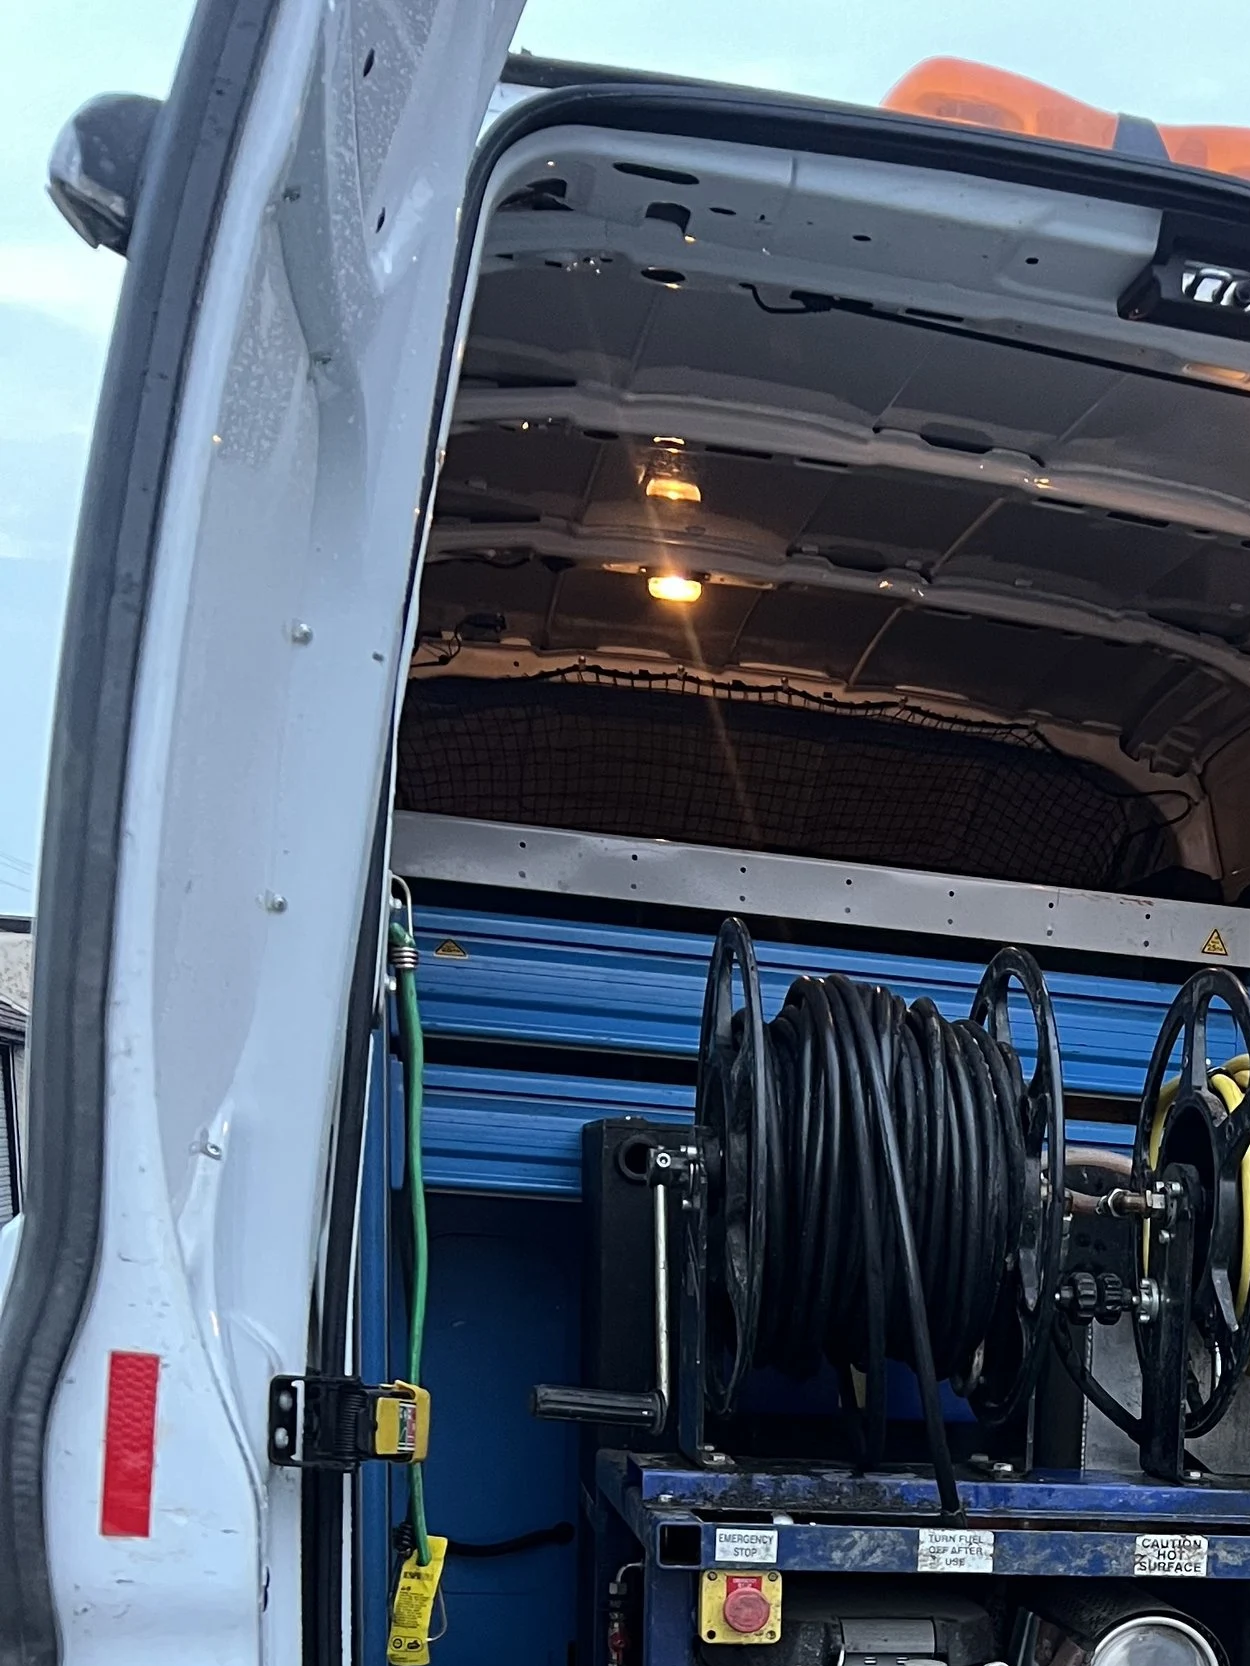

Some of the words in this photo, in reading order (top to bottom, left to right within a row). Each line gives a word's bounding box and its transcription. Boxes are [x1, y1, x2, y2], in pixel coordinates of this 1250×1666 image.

[718, 1533, 773, 1545] EMERGENCY
[928, 1533, 956, 1543] TURN
[958, 1534, 984, 1544] FUEL
[1141, 1538, 1202, 1549] CAUTION
[733, 1547, 758, 1558] STOP
[928, 1545, 949, 1554] OFF
[950, 1546, 984, 1556] AFTER
[1157, 1550, 1186, 1561] HOT
[945, 1557, 966, 1567] USE
[1139, 1561, 1202, 1573] SURFACE
